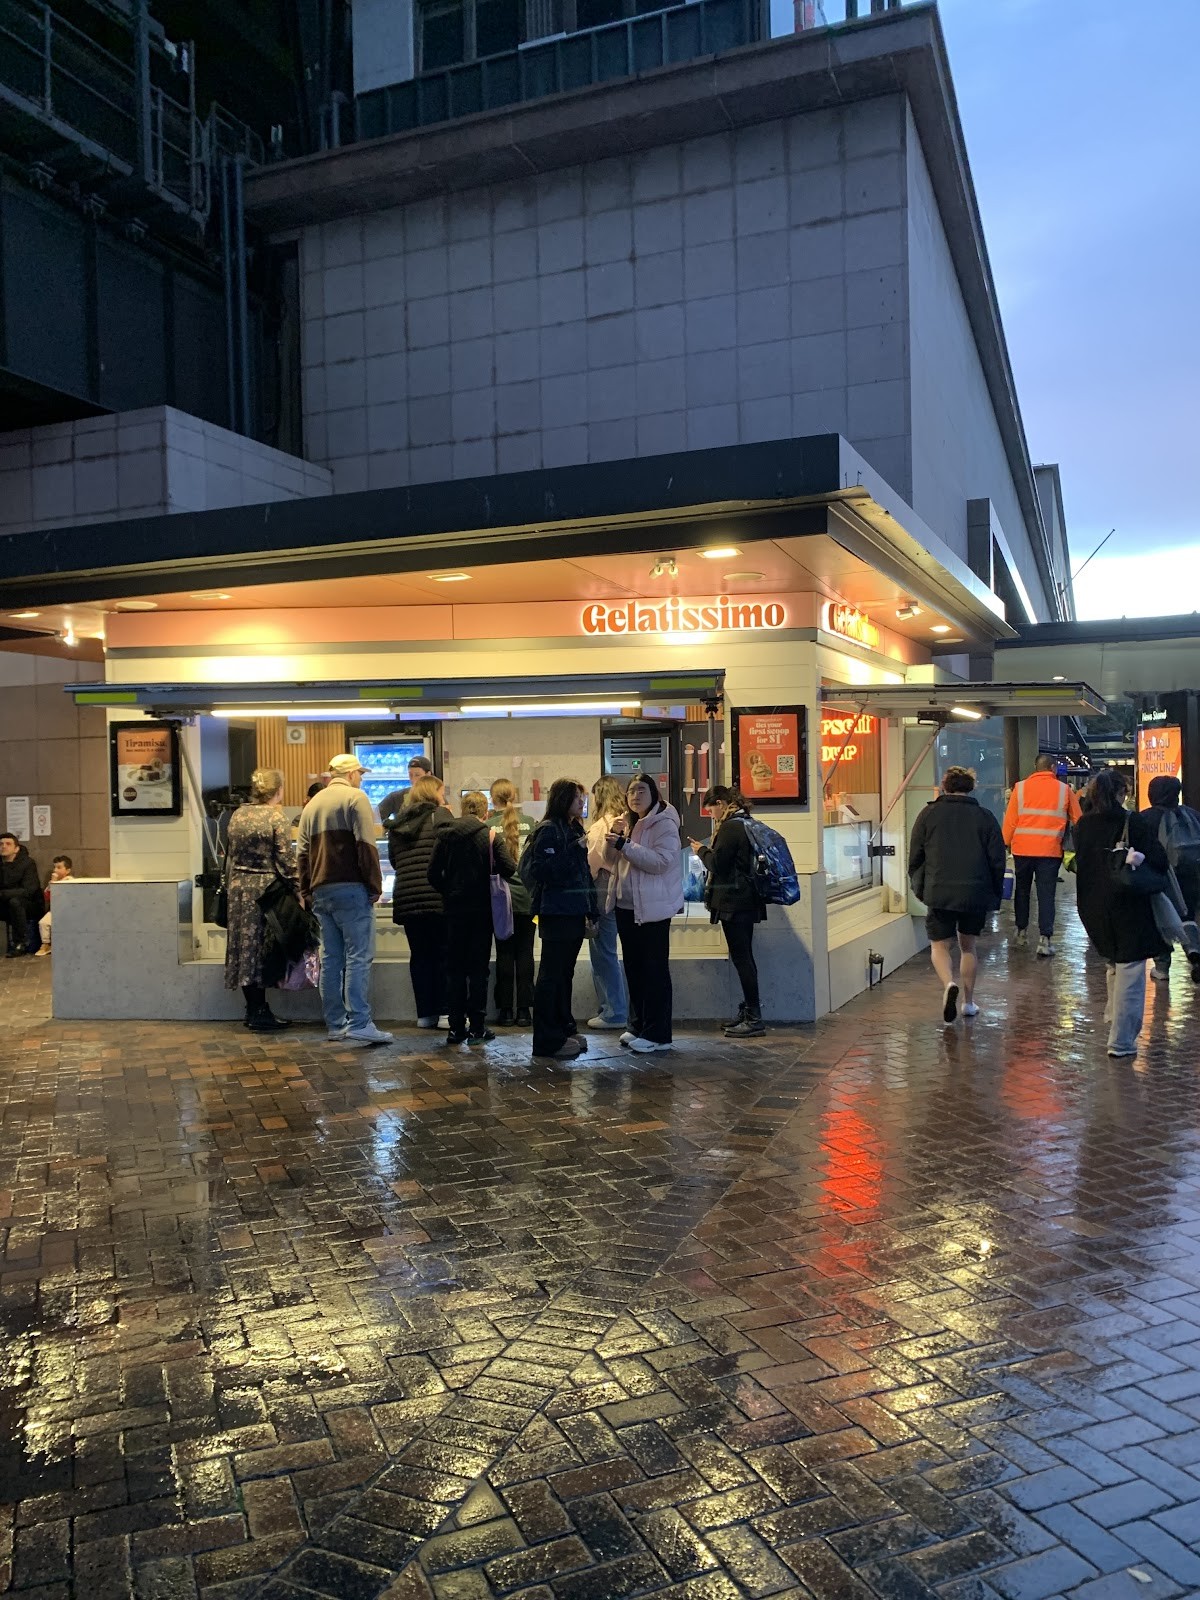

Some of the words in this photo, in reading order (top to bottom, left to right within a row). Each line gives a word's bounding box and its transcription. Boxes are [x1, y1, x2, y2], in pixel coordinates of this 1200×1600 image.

[583, 596, 785, 633] Gelatissimo
[749, 727, 766, 736] first
[766, 728, 790, 736] scoop
[767, 722, 783, 730] your
[769, 733, 781, 744] $1
[1145, 739, 1156, 750] SE
[1156, 738, 1170, 749] YOU
[1145, 750, 1152, 761] AT
[1152, 750, 1165, 761] THE
[1159, 762, 1176, 773] LINE
